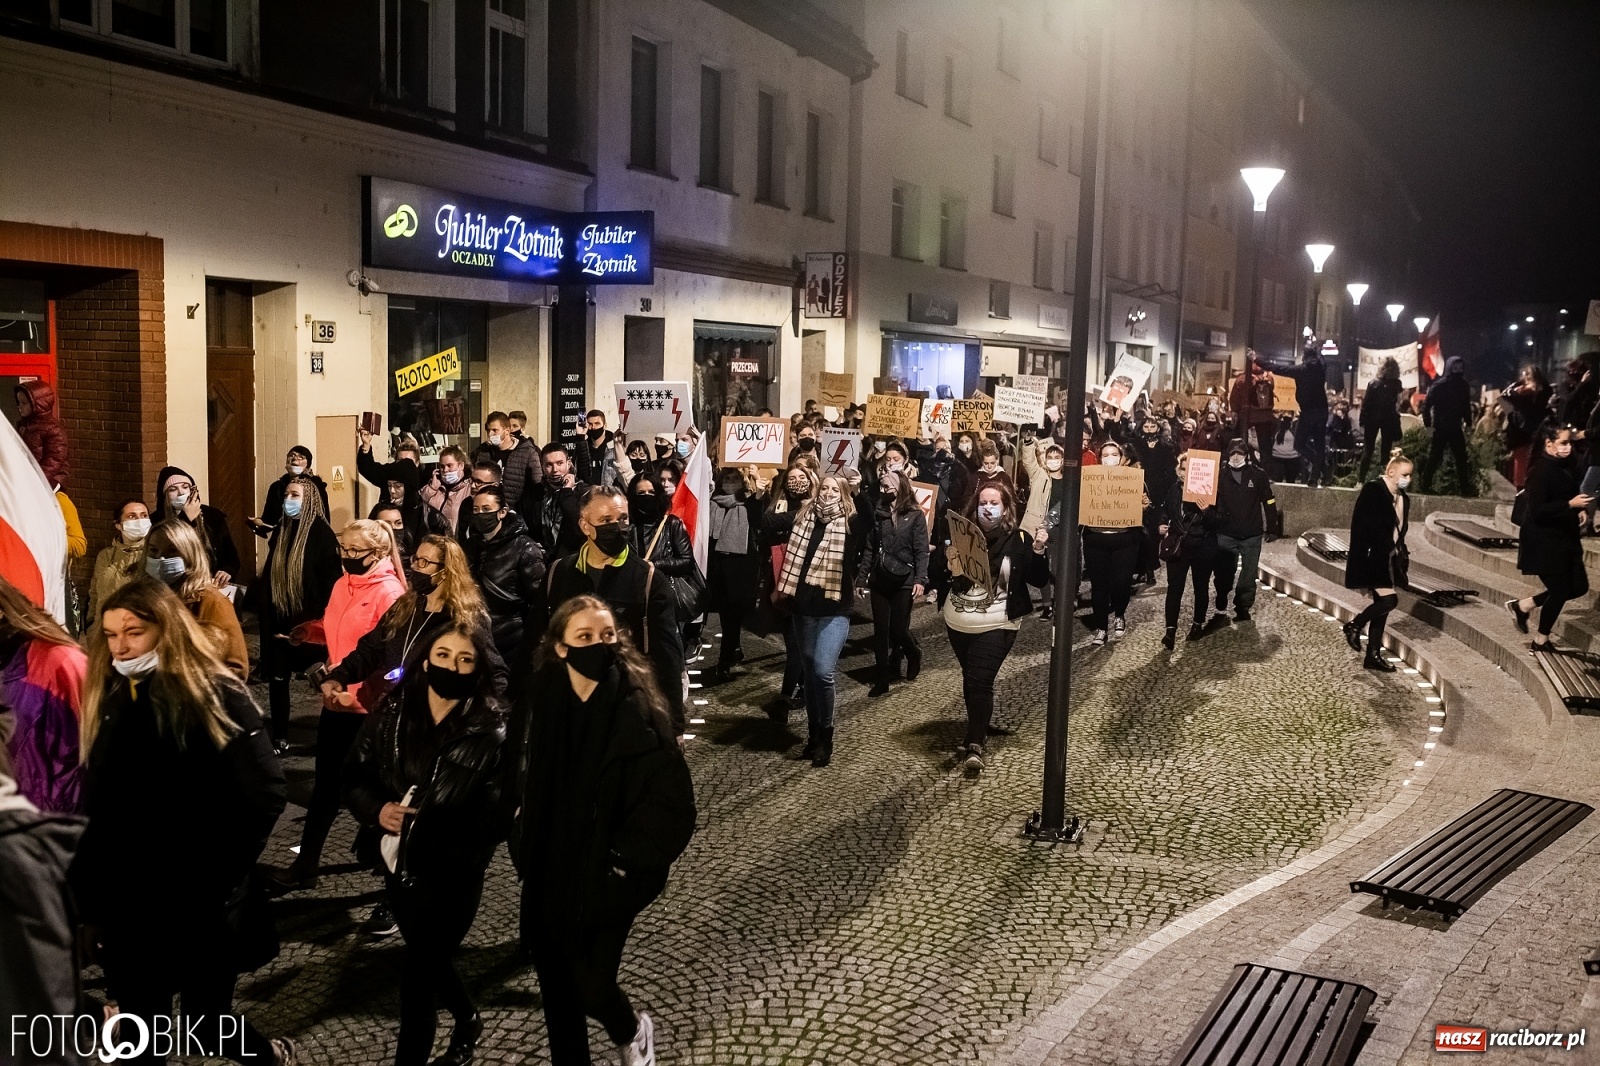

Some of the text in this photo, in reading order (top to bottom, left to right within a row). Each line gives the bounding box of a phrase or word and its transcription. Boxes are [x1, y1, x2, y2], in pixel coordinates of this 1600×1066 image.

[435, 204, 564, 262] Jubiler Złotnik
[582, 224, 636, 251] Jubiler
[451, 250, 496, 268] OCZADŁY
[582, 252, 638, 277] Złotnik
[319, 325, 334, 338] 36
[313, 358, 322, 370] 36
[398, 352, 457, 393] ZŁOTO -10%
[731, 361, 759, 374] PRZECENA
[868, 395, 911, 409] JAK CHCESZ
[953, 400, 993, 411] EFEDRON
[899, 409, 910, 418] DO
[727, 422, 783, 452] ABORCJA?
[951, 516, 966, 536] TO
